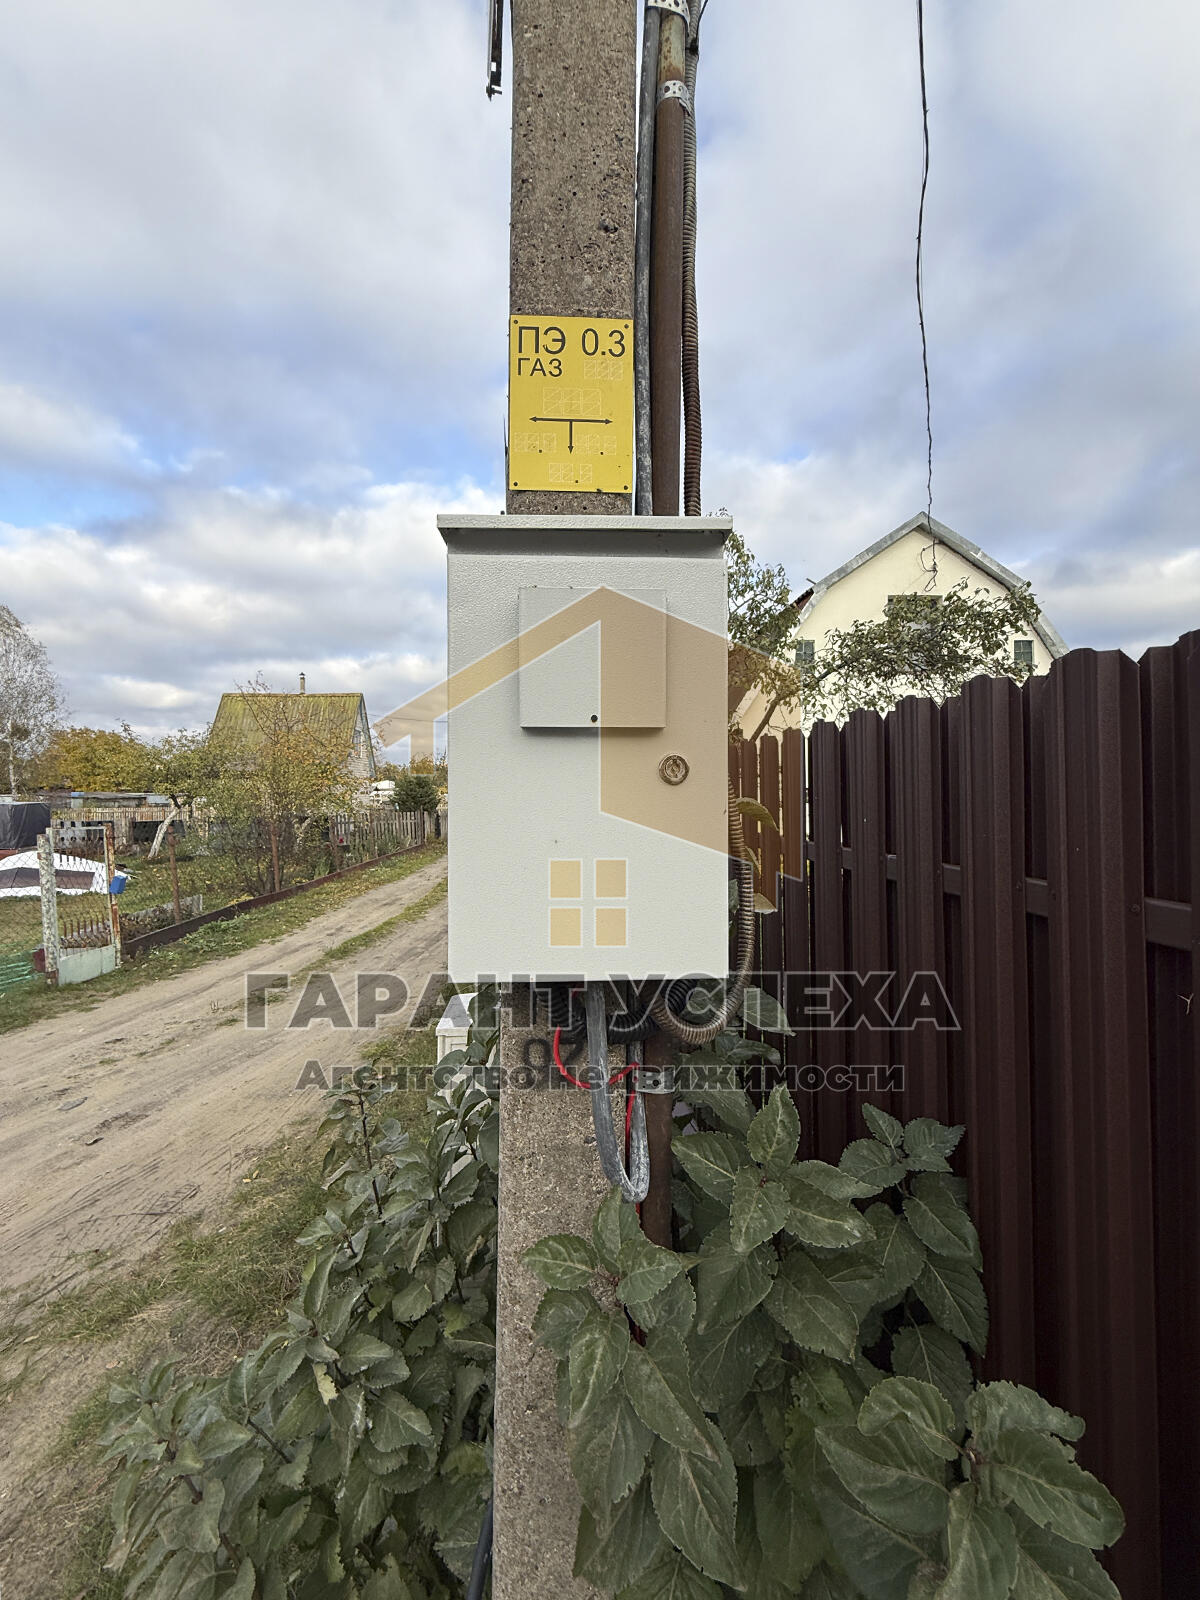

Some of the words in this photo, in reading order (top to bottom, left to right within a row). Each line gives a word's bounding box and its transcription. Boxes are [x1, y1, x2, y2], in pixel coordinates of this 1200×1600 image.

[518, 326, 566, 354] ПЭ
[581, 328, 626, 357] 0.3
[517, 357, 563, 377] ГАЗ
